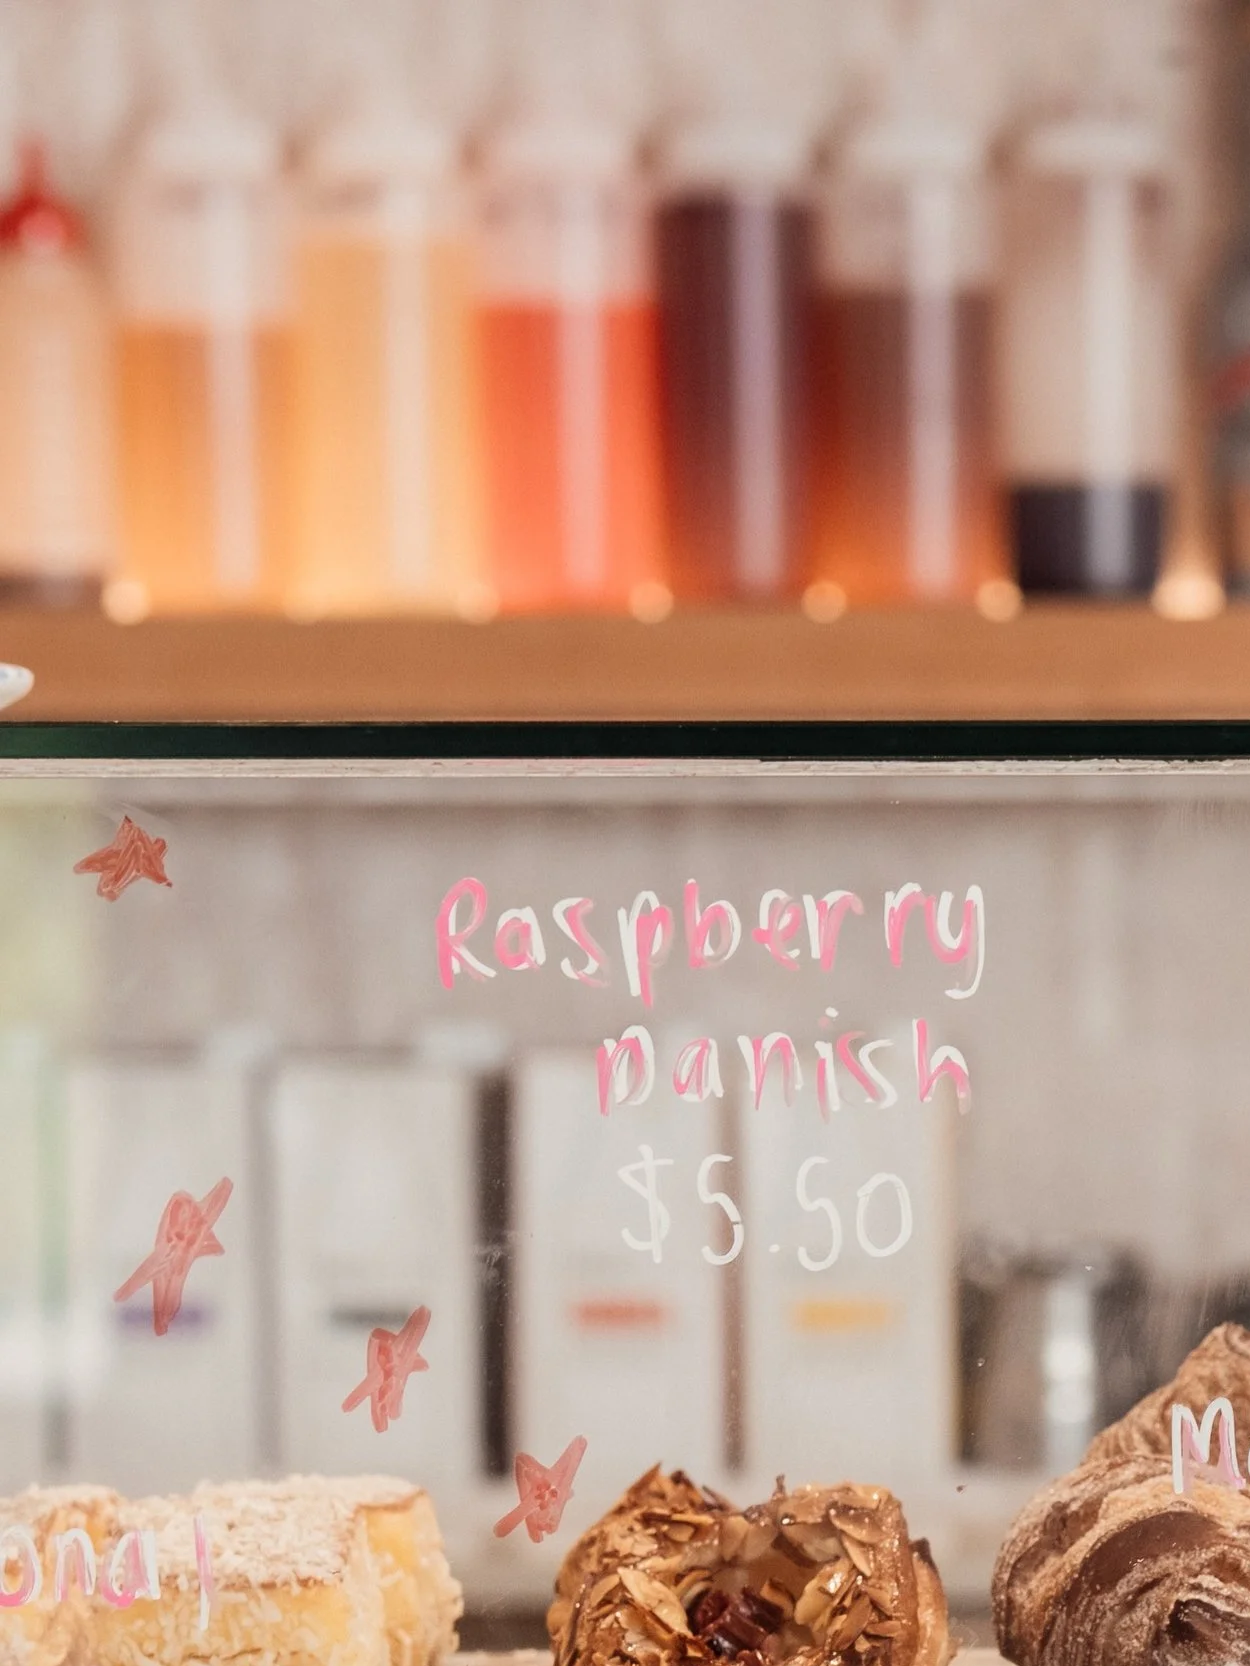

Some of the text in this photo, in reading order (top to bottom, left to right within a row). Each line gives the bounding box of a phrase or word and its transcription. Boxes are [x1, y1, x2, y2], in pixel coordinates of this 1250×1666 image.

[436, 877, 985, 1009] Raspberry
[597, 1007, 971, 1123] Danish
[619, 1145, 912, 1272] $5.50
